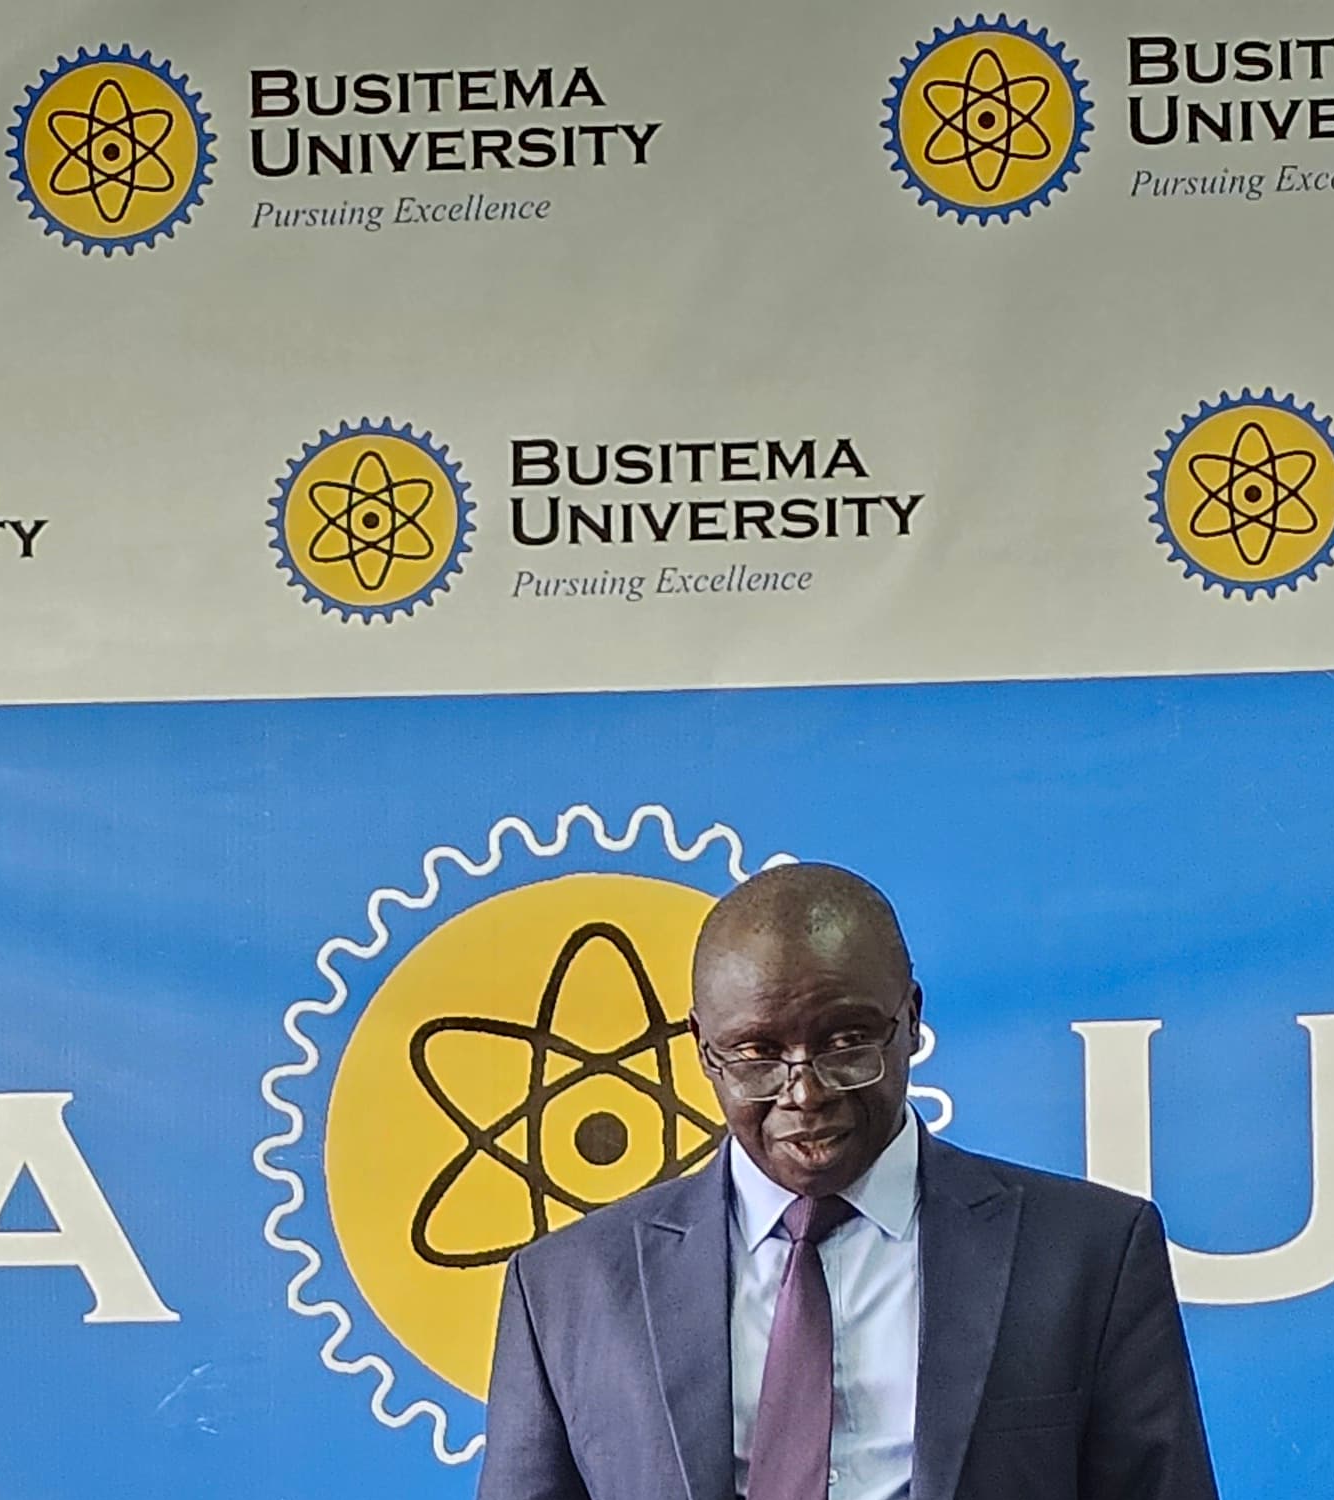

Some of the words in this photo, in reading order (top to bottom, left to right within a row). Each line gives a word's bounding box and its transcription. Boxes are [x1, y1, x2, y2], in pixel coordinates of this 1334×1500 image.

[251, 67, 607, 118] BUSITEMA
[251, 123, 662, 177] UNIVERSITY
[1131, 168, 1265, 200] Pursuing
[251, 200, 384, 232] Pursuing
[393, 194, 551, 223] Excellence
[511, 438, 869, 487] BUSITEMA
[510, 494, 925, 545] UNIVERSITY
[512, 570, 646, 602] Pursuing
[655, 564, 813, 593] Excellence
